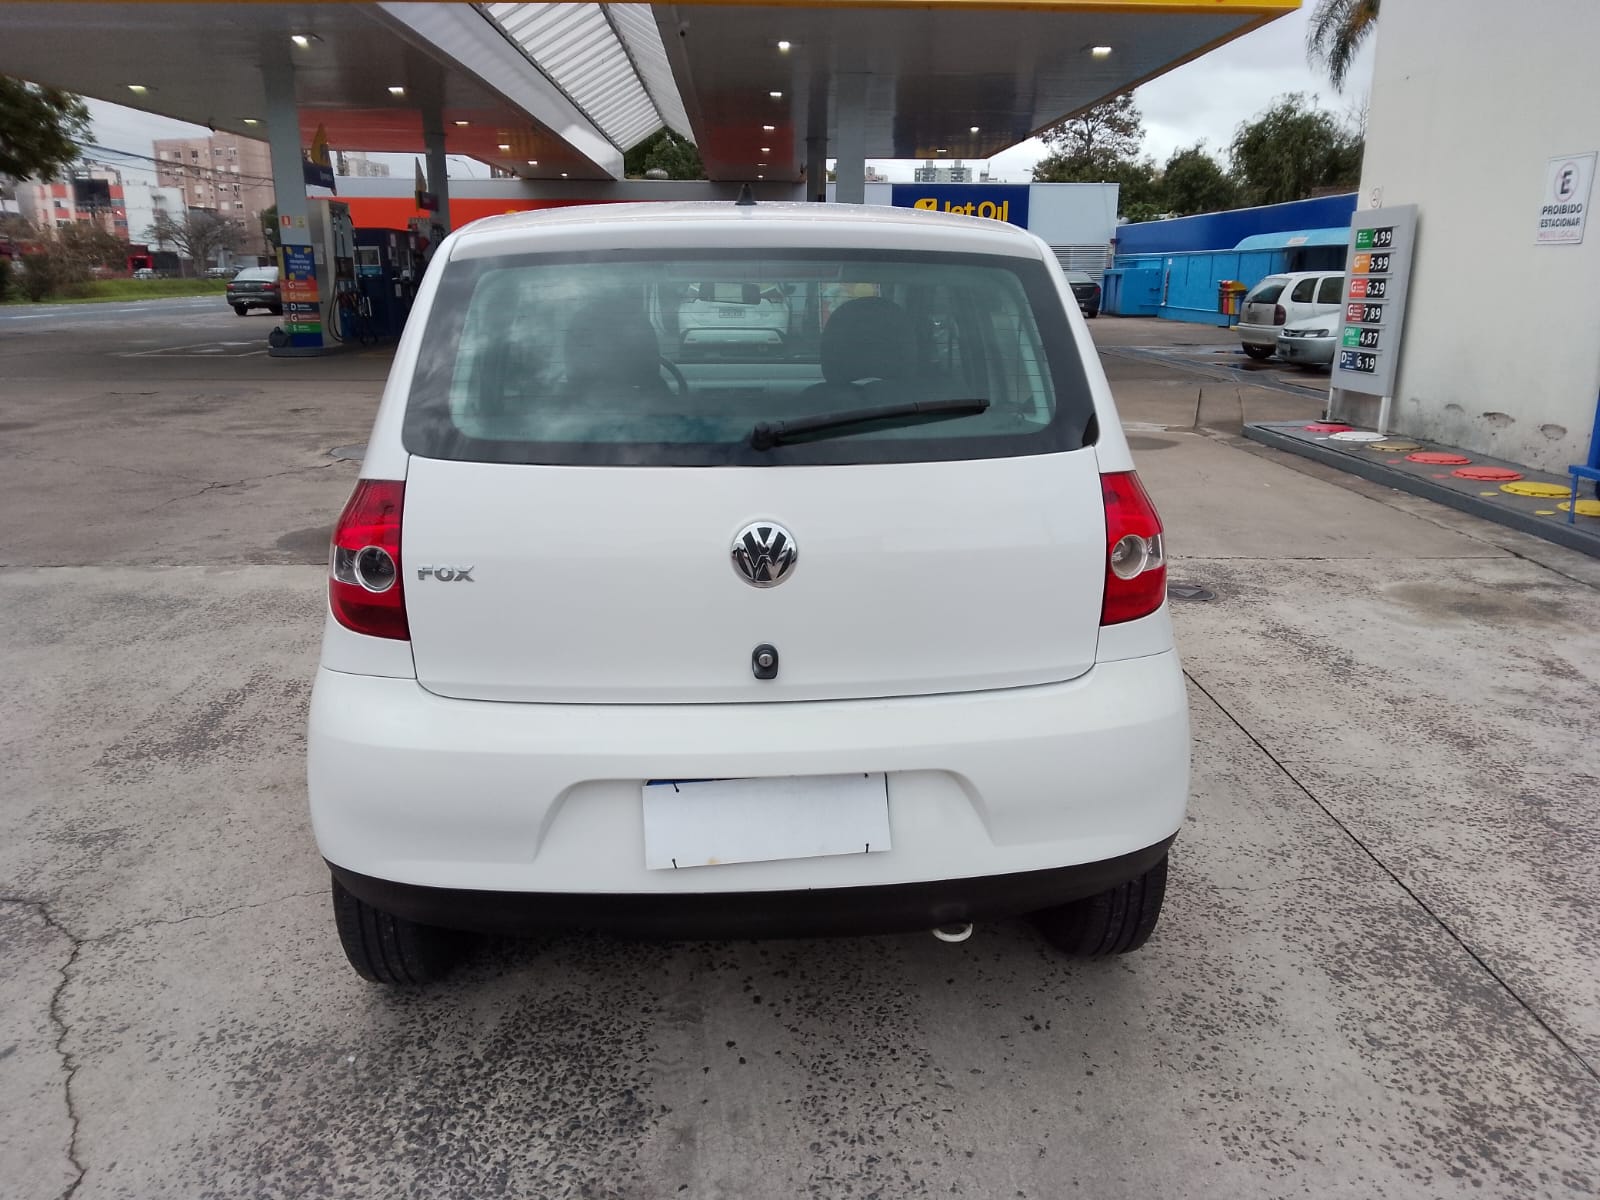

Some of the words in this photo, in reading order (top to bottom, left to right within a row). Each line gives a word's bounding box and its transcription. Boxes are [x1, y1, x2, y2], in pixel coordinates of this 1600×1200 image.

[1542, 203, 1582, 215] PROIBIDO
[1540, 218, 1580, 228] ESTACIONAR
[1373, 231, 1392, 246] 4,99
[1369, 256, 1389, 270] 5,99
[1366, 282, 1385, 295] 6,29
[1363, 307, 1381, 321] 7,89
[1360, 332, 1379, 345] 4,87
[1356, 356, 1375, 369] 6,19
[417, 564, 475, 582] FOX
